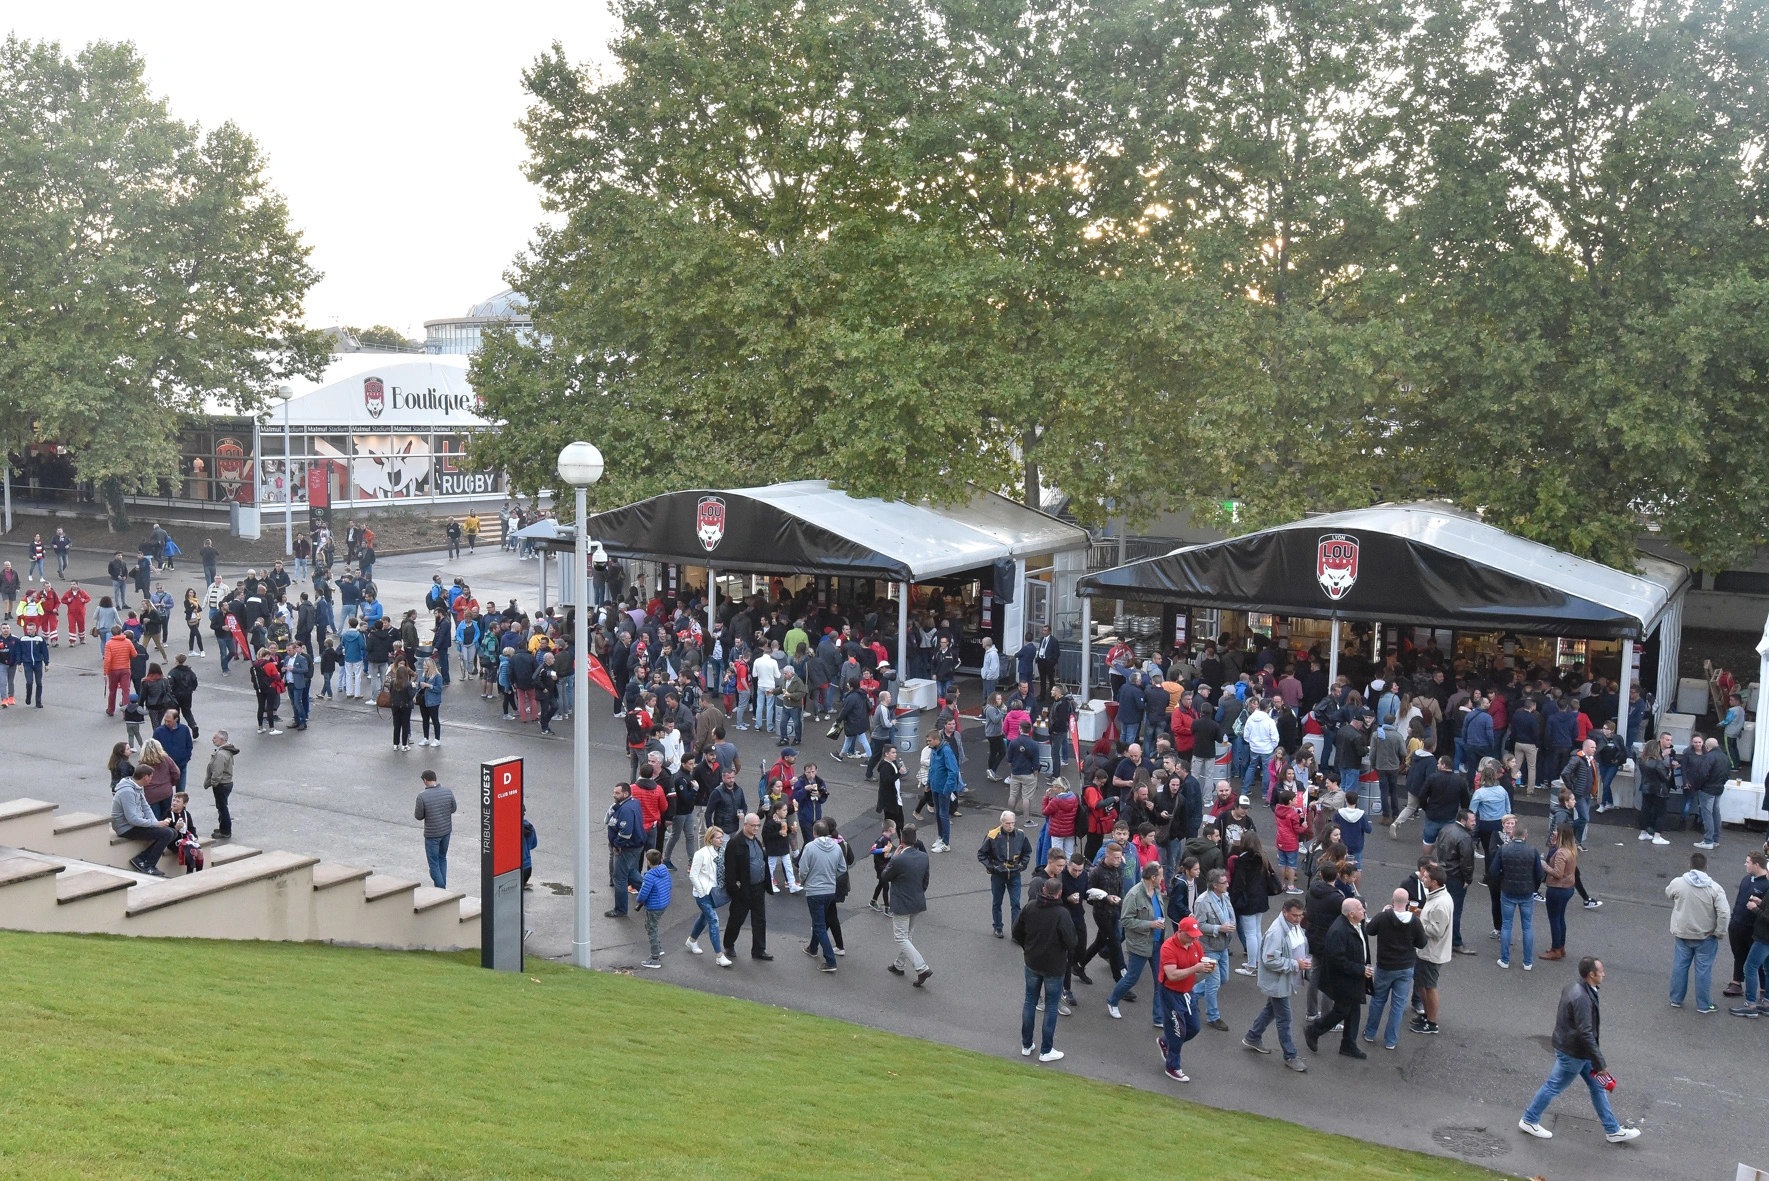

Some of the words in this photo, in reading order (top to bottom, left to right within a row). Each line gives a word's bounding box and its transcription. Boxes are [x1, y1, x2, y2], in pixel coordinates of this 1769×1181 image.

[391, 387, 469, 415] Boutique
[442, 473, 494, 494] RUGBY
[701, 505, 722, 517] LOU
[1323, 544, 1354, 559] LOU
[483, 767, 491, 805] OUEST
[503, 772, 512, 785] D
[497, 791, 508, 799] CLUB
[483, 808, 491, 854] TRIBUNE
